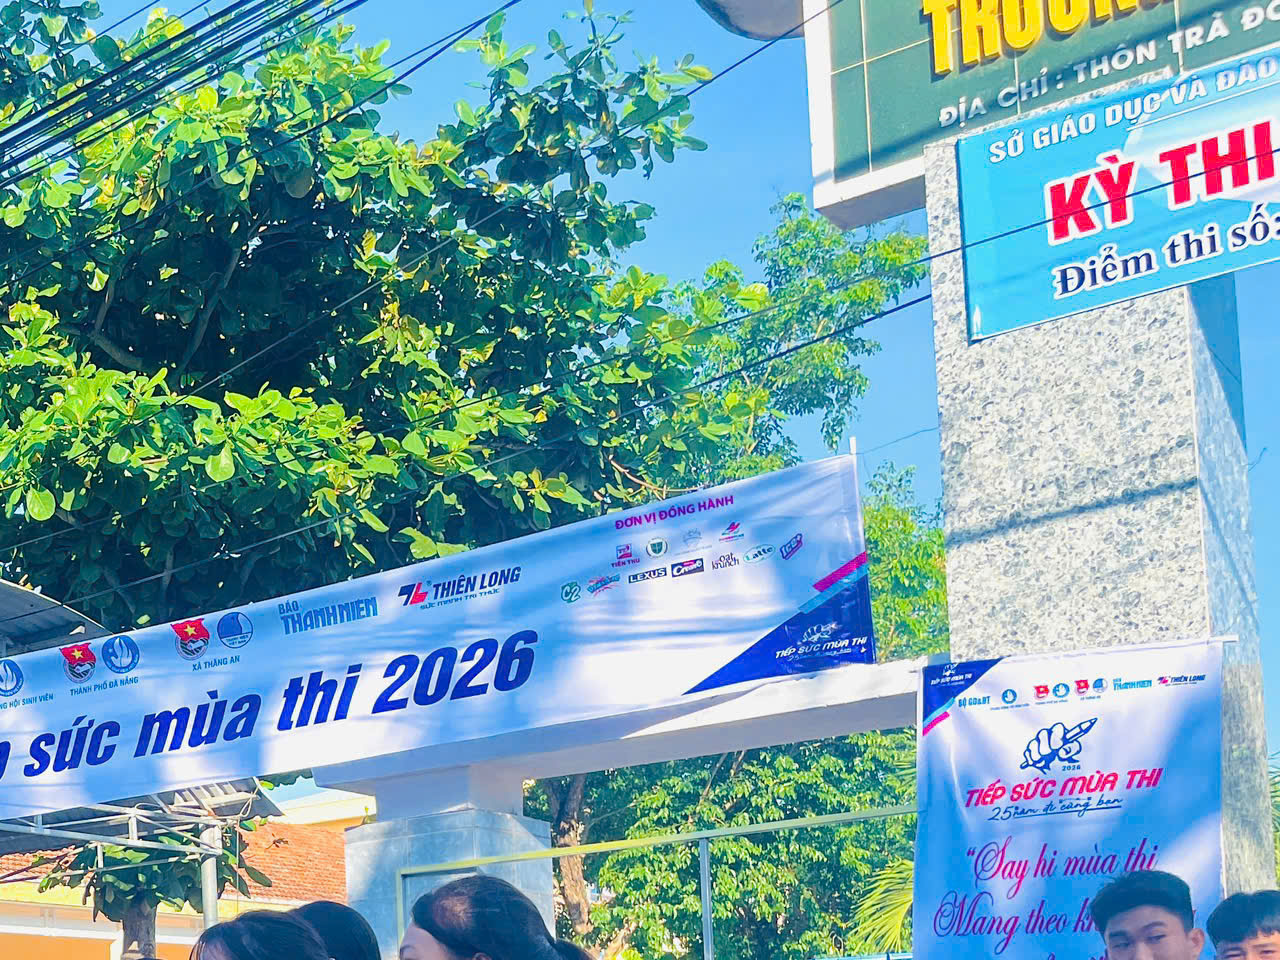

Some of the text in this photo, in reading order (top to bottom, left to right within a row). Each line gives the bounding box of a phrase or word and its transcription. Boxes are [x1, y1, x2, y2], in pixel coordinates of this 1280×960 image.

[939, 96, 988, 128] ĐỊA
[997, 66, 1049, 108] CHỈ
[1073, 41, 1157, 84] THÔN
[989, 128, 1026, 163] SỞ
[1032, 113, 1096, 150] GIÁO
[1104, 92, 1162, 127] DỤC
[1170, 75, 1207, 105] VÀ
[1049, 120, 1275, 241] KỲ THI
[1057, 246, 1155, 296] Điểm
[1167, 226, 1221, 264] thi
[615, 495, 734, 530] ĐƠN VỊ ĐỒNG HÀNH
[433, 566, 521, 600] THIÊN LONG
[562, 582, 581, 602] C2
[629, 567, 666, 583] LEXUS
[279, 600, 299, 614] BÁO
[230, 654, 241, 665] AN
[775, 645, 797, 658] TIẾP
[797, 643, 821, 654] SỨC
[822, 638, 849, 650] MÙA
[851, 636, 868, 646] THI
[8, 699, 20, 711] HỘI
[21, 696, 38, 707] SINH
[39, 692, 54, 703] VIÊN
[94, 680, 108, 692] PHỐ
[23, 714, 121, 778] sức
[133, 690, 263, 758] mùa
[277, 665, 365, 734] thi
[371, 629, 539, 714] 2026
[965, 768, 1164, 808] TIẾP SỨC MÙA THI
[988, 806, 1014, 821] 25
[1033, 843, 1058, 879] hi
[1064, 843, 1120, 877] mùa
[1123, 837, 1159, 872] thi
[933, 890, 1021, 955] Mang
[1025, 900, 1068, 935] theo
